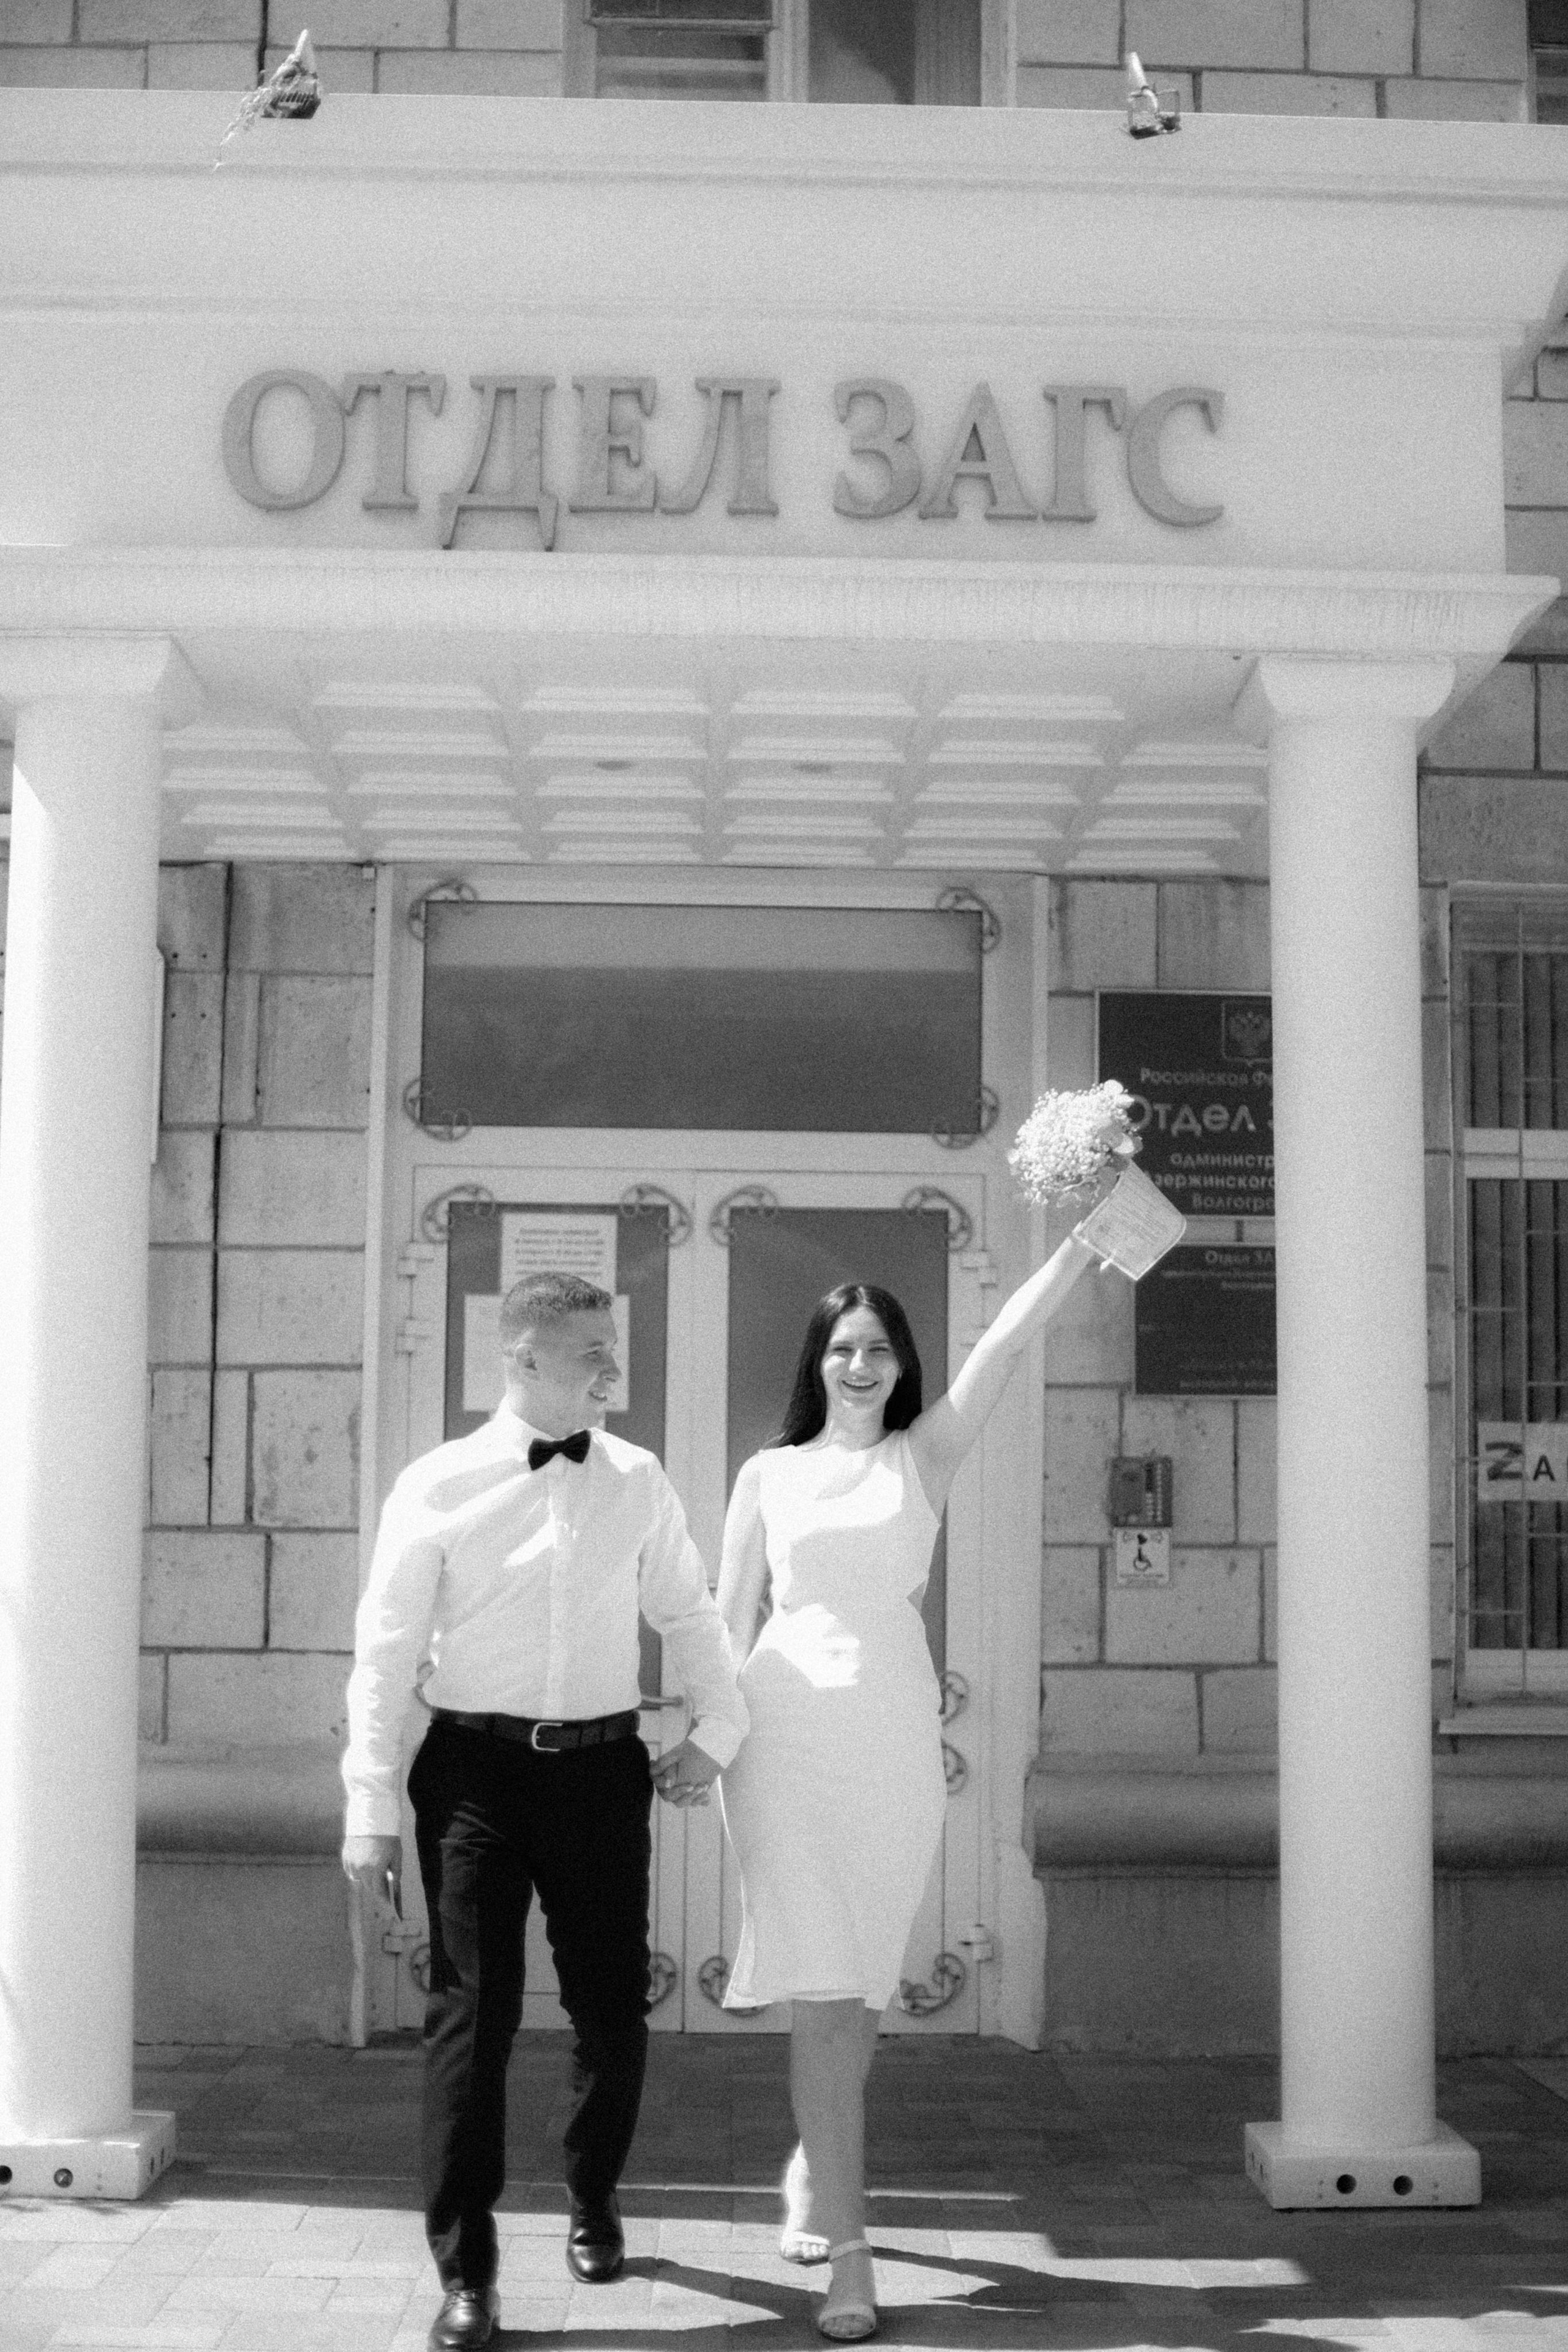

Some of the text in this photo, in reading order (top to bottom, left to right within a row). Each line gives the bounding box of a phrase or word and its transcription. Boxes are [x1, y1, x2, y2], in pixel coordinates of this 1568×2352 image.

[222, 369, 1225, 550] ОТДЕЛ ЗАГС
[1140, 1068, 1248, 1086] Российская
[1128, 1094, 1256, 1137] Отдел
[1485, 1441, 1568, 1482] ZA
